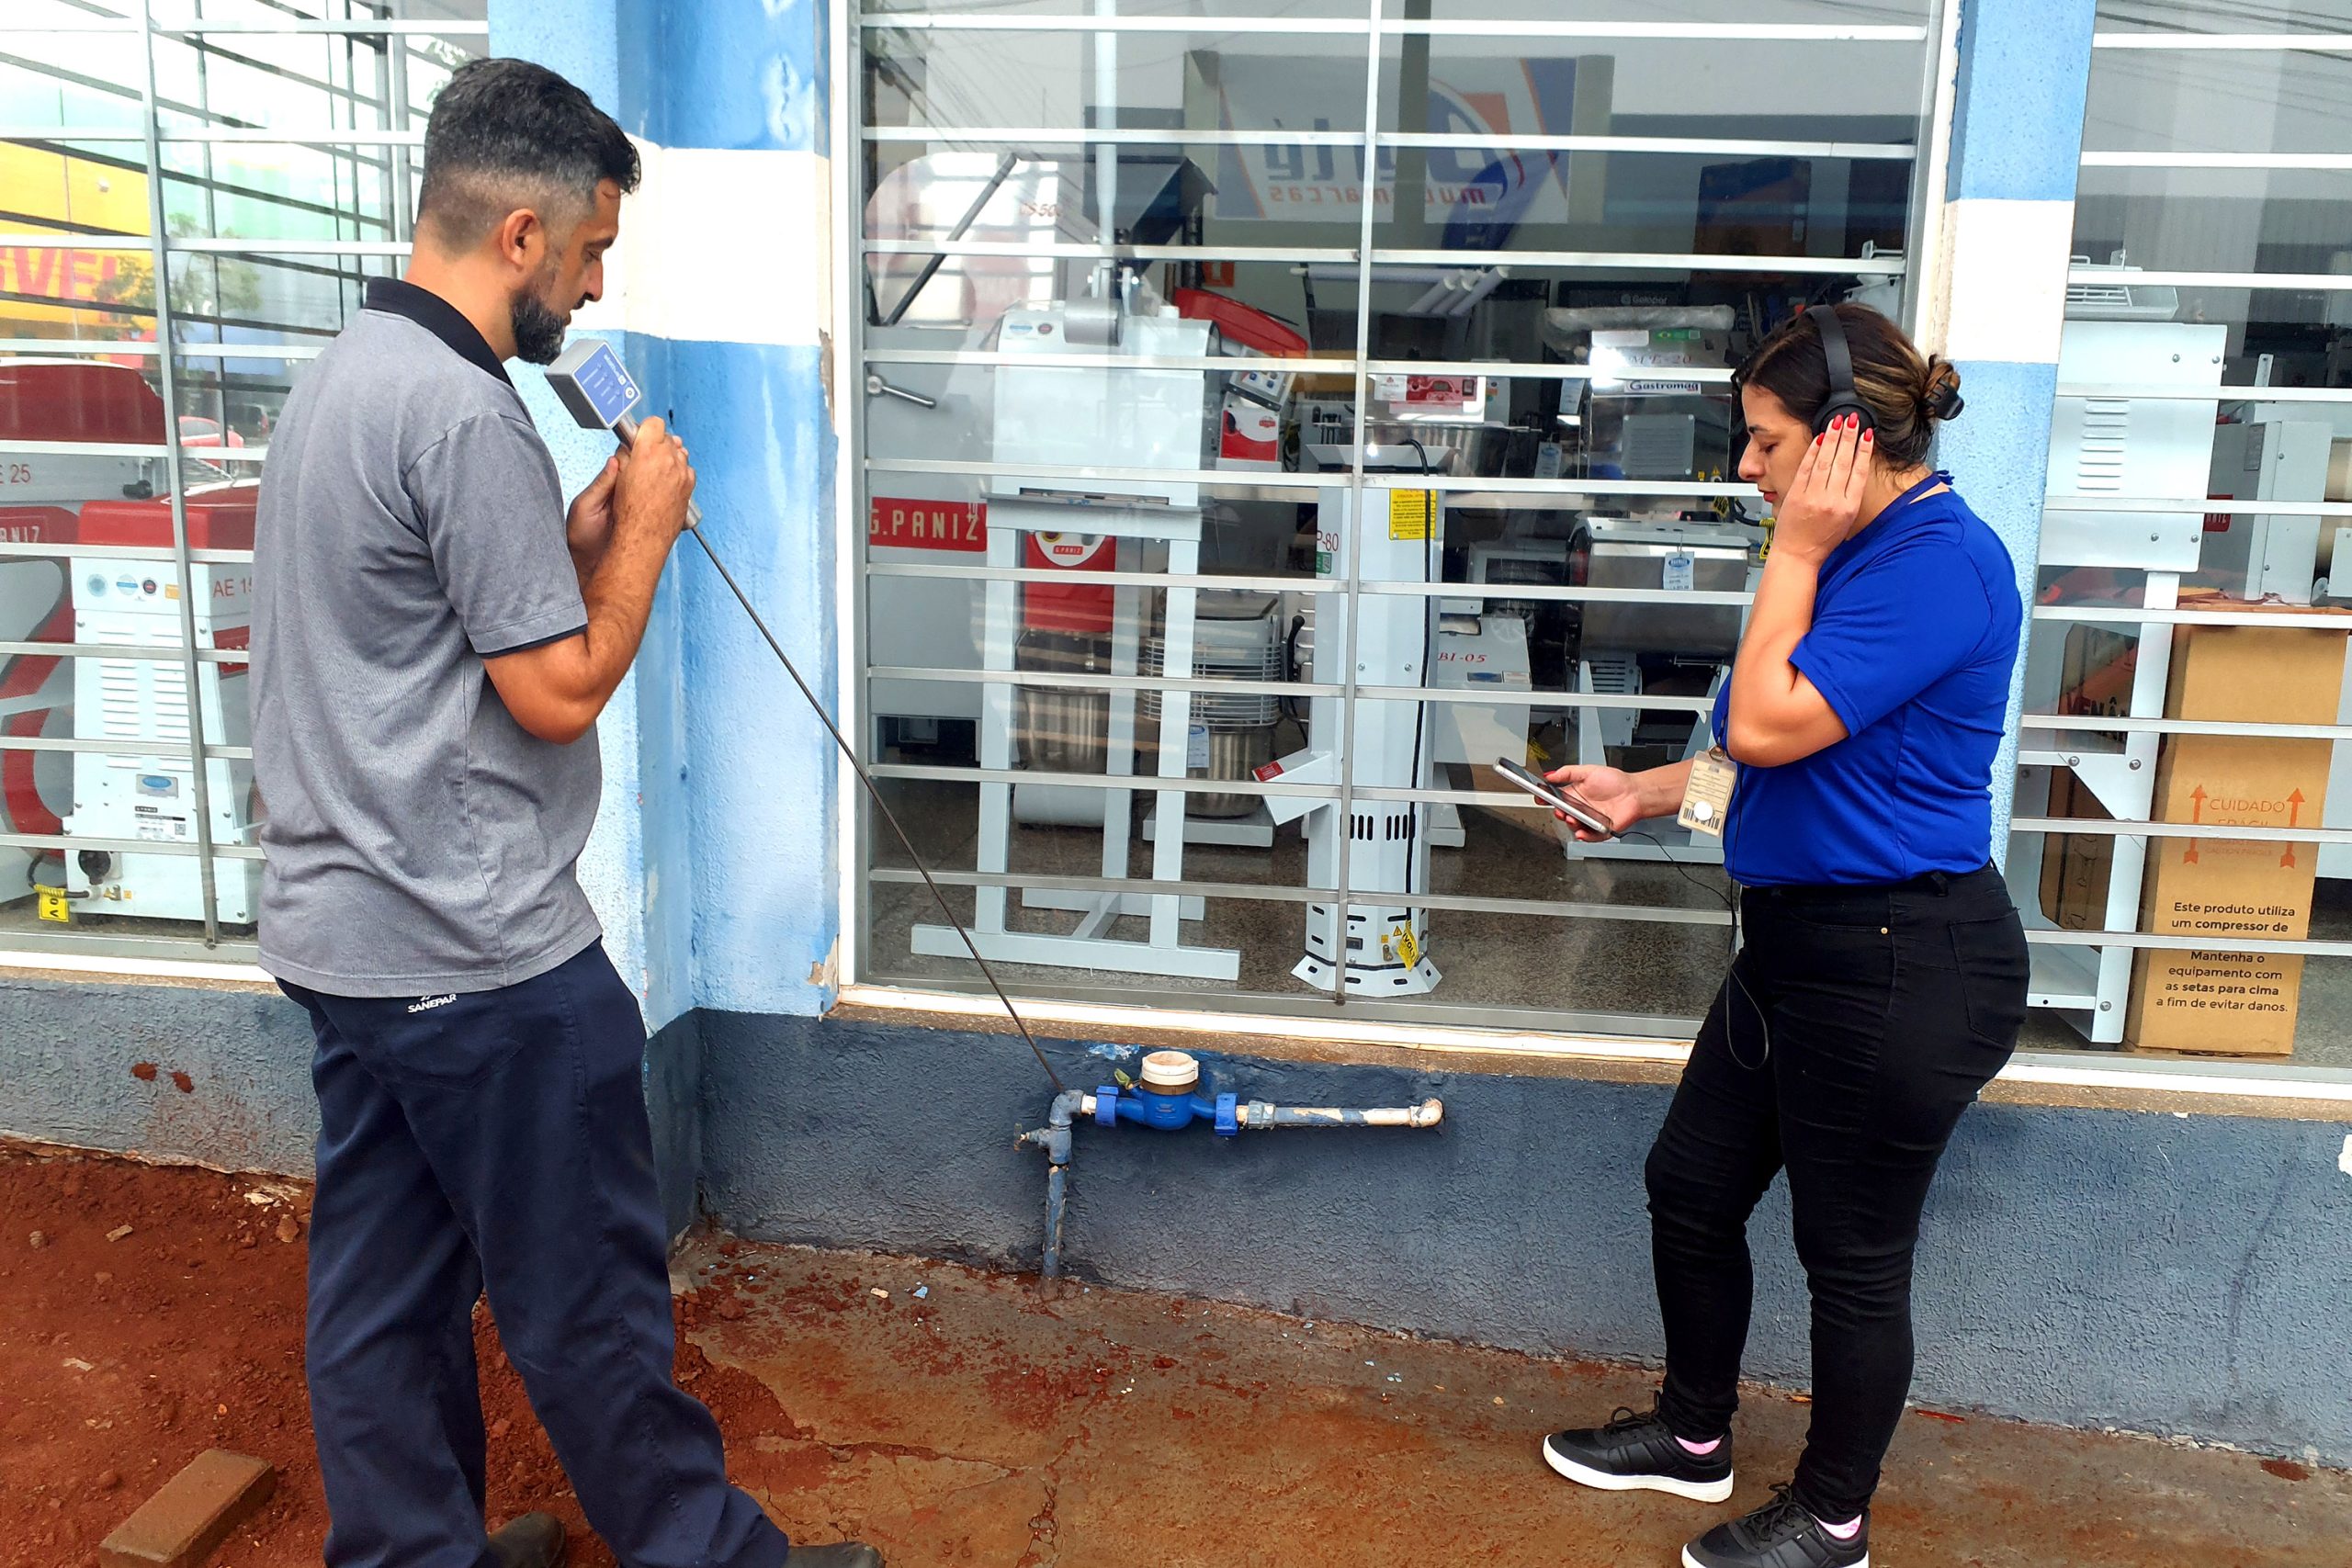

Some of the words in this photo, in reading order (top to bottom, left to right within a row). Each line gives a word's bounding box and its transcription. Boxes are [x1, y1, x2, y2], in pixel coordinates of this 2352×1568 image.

[10, 464, 31, 483] 25
[213, 579, 235, 598] AE
[1438, 651, 1487, 663] BI-05
[2210, 798, 2286, 813] CUIDADO
[2174, 902, 2200, 912] Este
[2204, 904, 2255, 914] produto
[2257, 906, 2295, 917] utiliza
[2172, 919, 2191, 928] um
[2195, 920, 2269, 931] compressor
[2272, 922, 2289, 932] de
[2190, 951, 2253, 963] Mantenha
[2256, 955, 2265, 964] o
[2168, 967, 2252, 978] equipamento
[2165, 983, 2178, 991] as
[2182, 984, 2215, 992] setas
[2218, 986, 2245, 994] para
[2249, 985, 2279, 996] cima
[407, 993, 458, 1013] SANEPAR
[2156, 998, 2164, 1007] a
[2167, 998, 2187, 1008] fim
[2190, 998, 2206, 1009] de
[2210, 999, 2245, 1010] evitar
[2248, 1001, 2289, 1012] danos.
